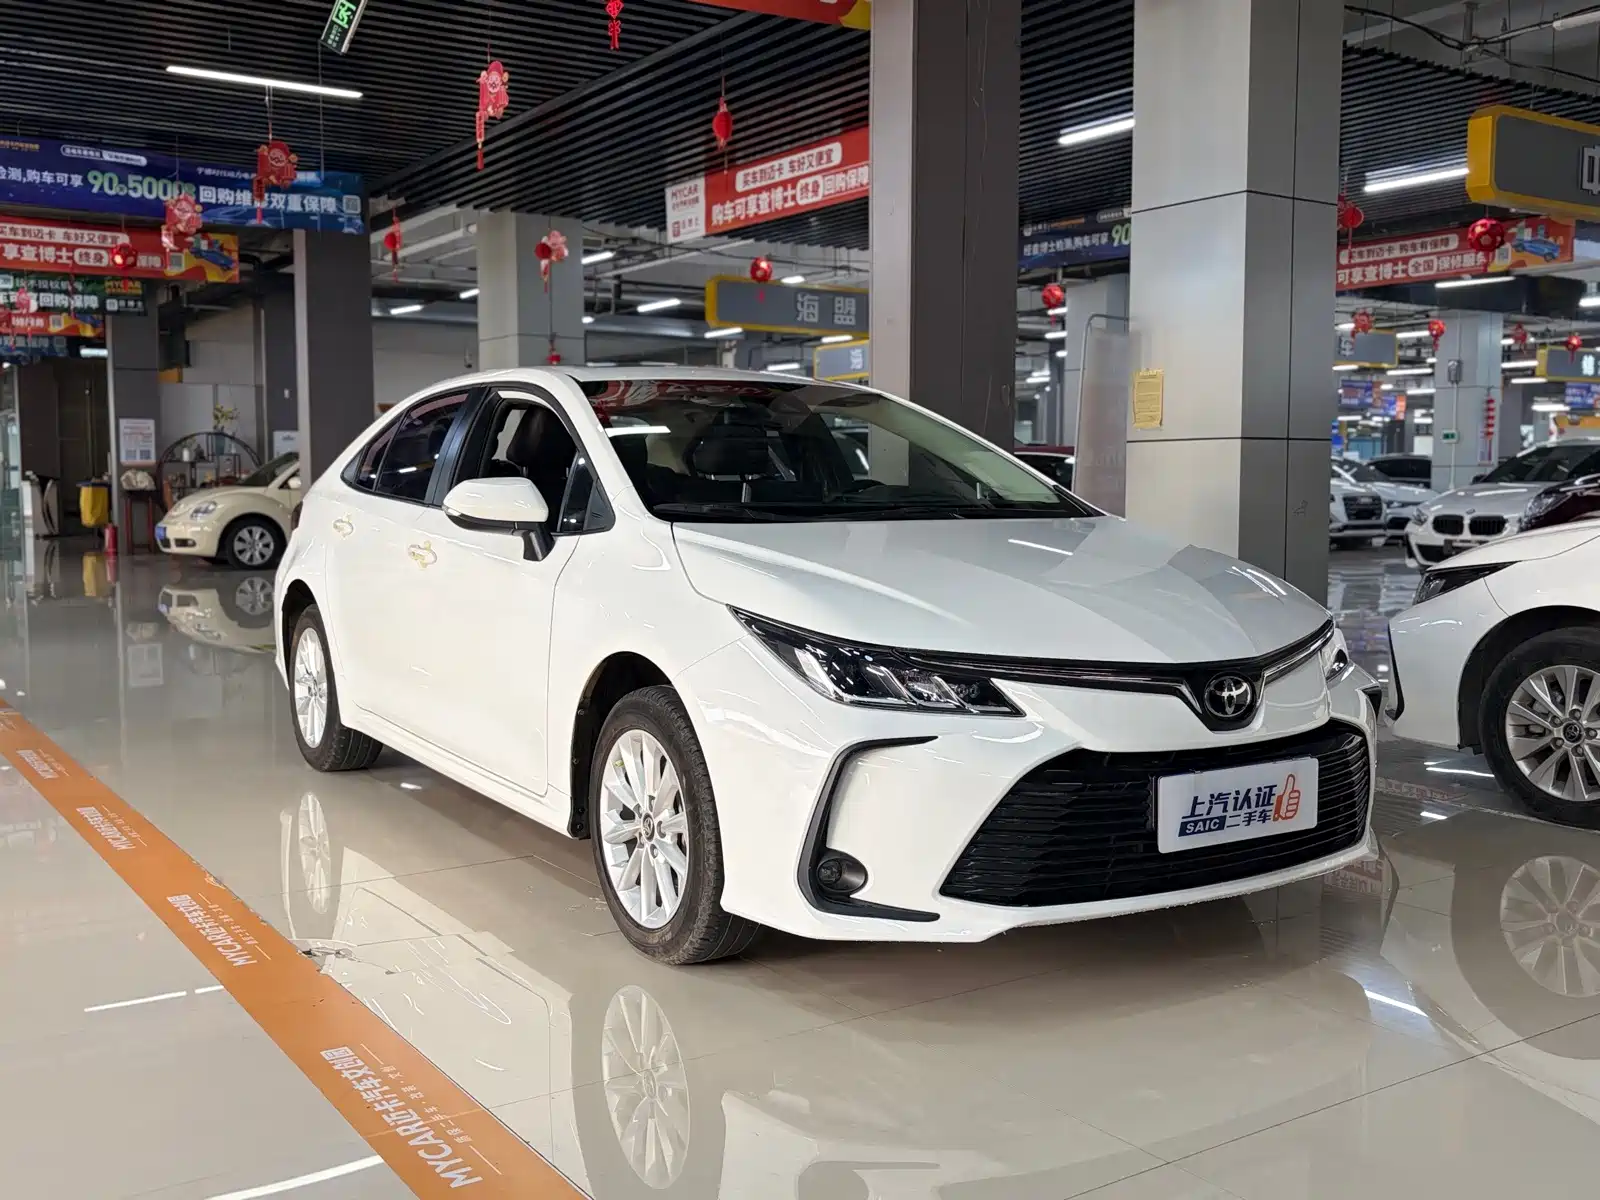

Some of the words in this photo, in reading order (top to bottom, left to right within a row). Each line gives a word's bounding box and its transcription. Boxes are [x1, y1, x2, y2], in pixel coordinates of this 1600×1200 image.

[1182, 785, 1277, 819] 上汽认证
[1186, 820, 1220, 833] SAIC
[1227, 809, 1273, 828] 二手车
